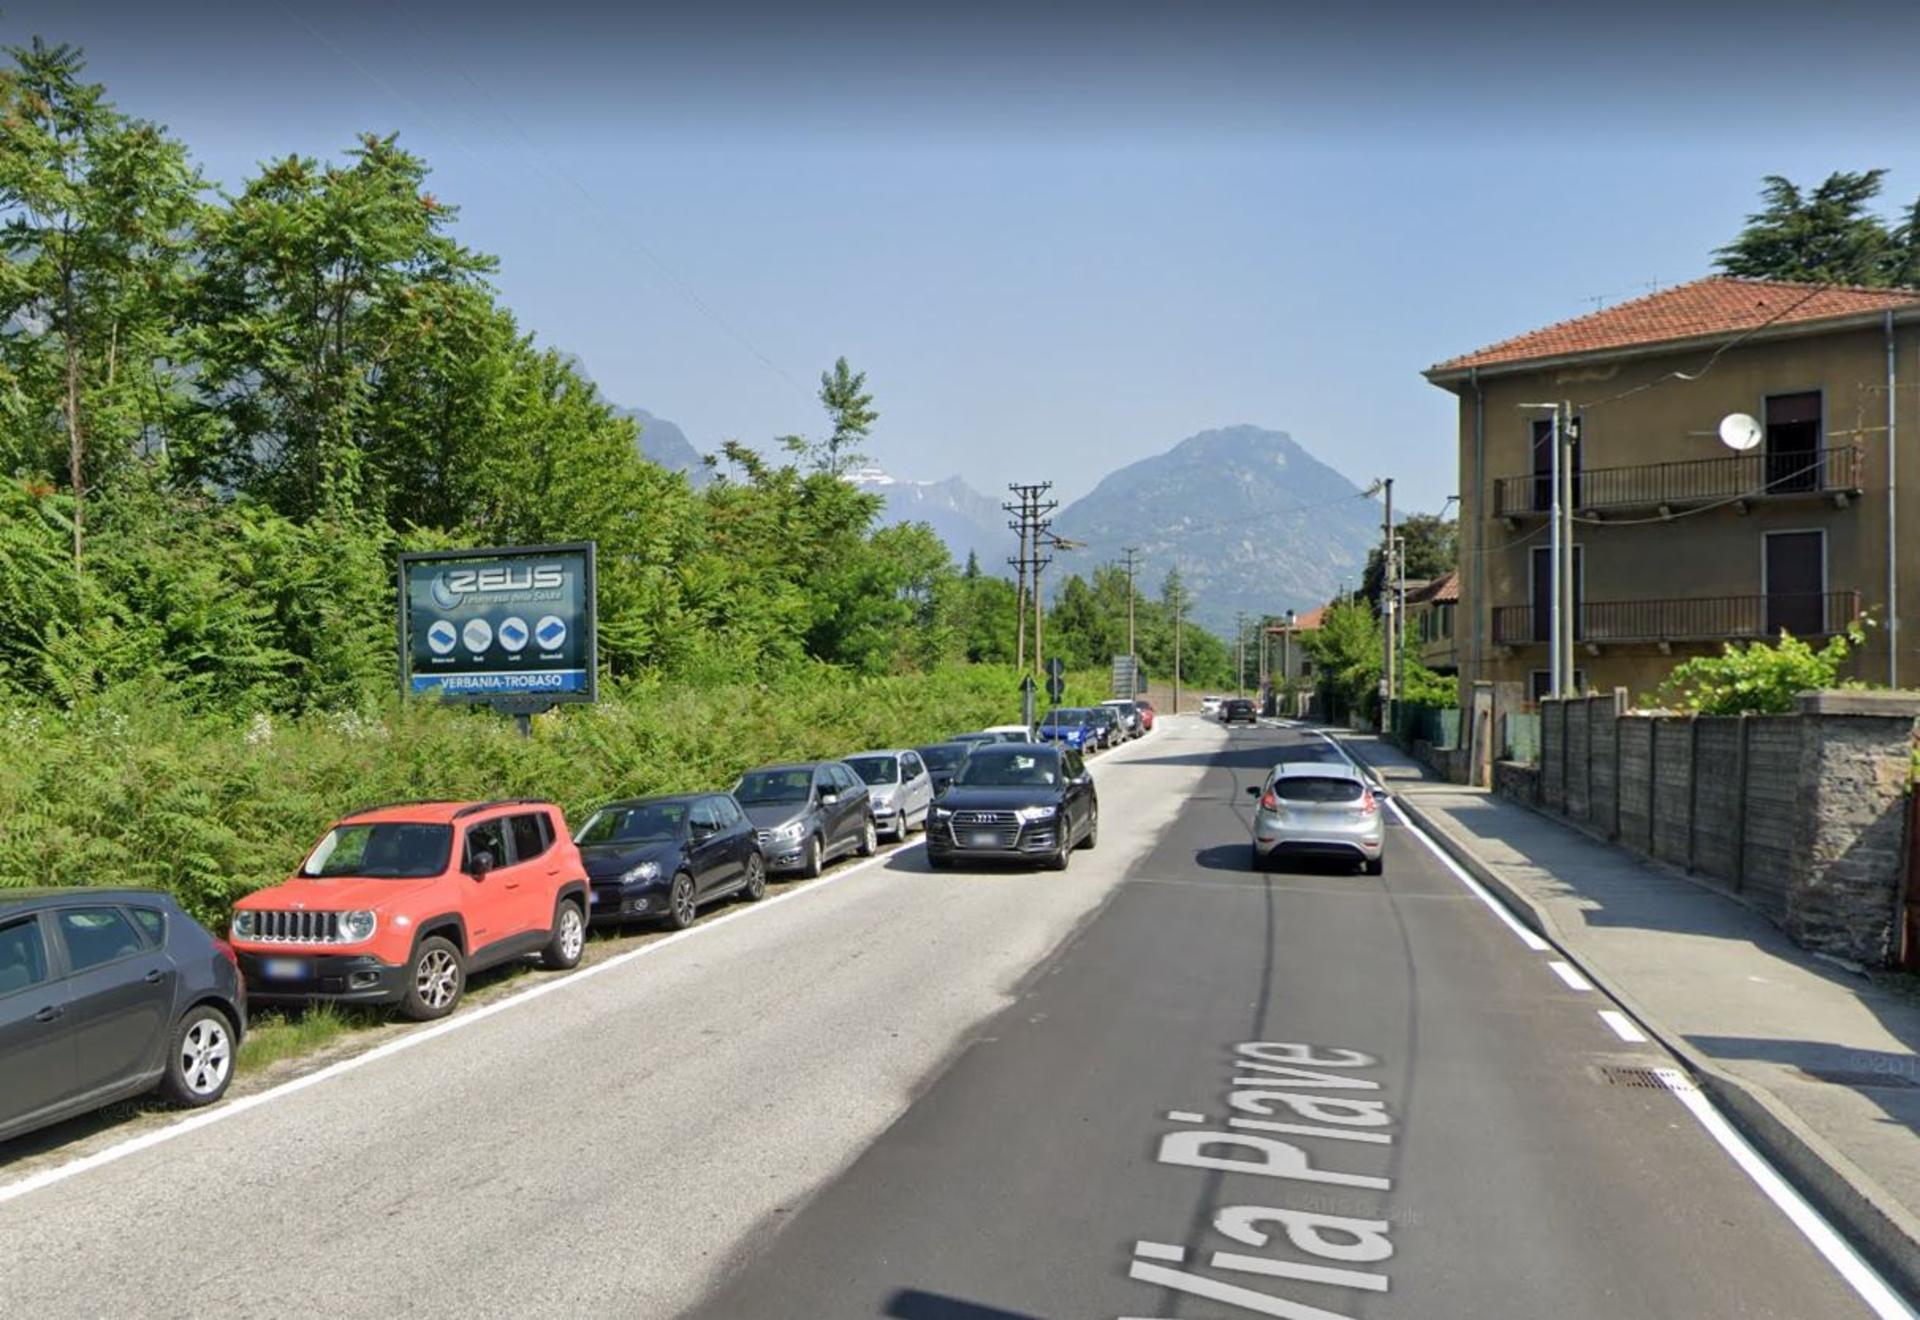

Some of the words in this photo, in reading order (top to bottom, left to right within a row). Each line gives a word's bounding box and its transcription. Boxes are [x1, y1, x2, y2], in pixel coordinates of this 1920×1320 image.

[450, 565, 562, 592] ZEUS
[440, 674, 562, 689] VERBANIA-TROBASO
[1157, 1041, 1392, 1190] Piave
